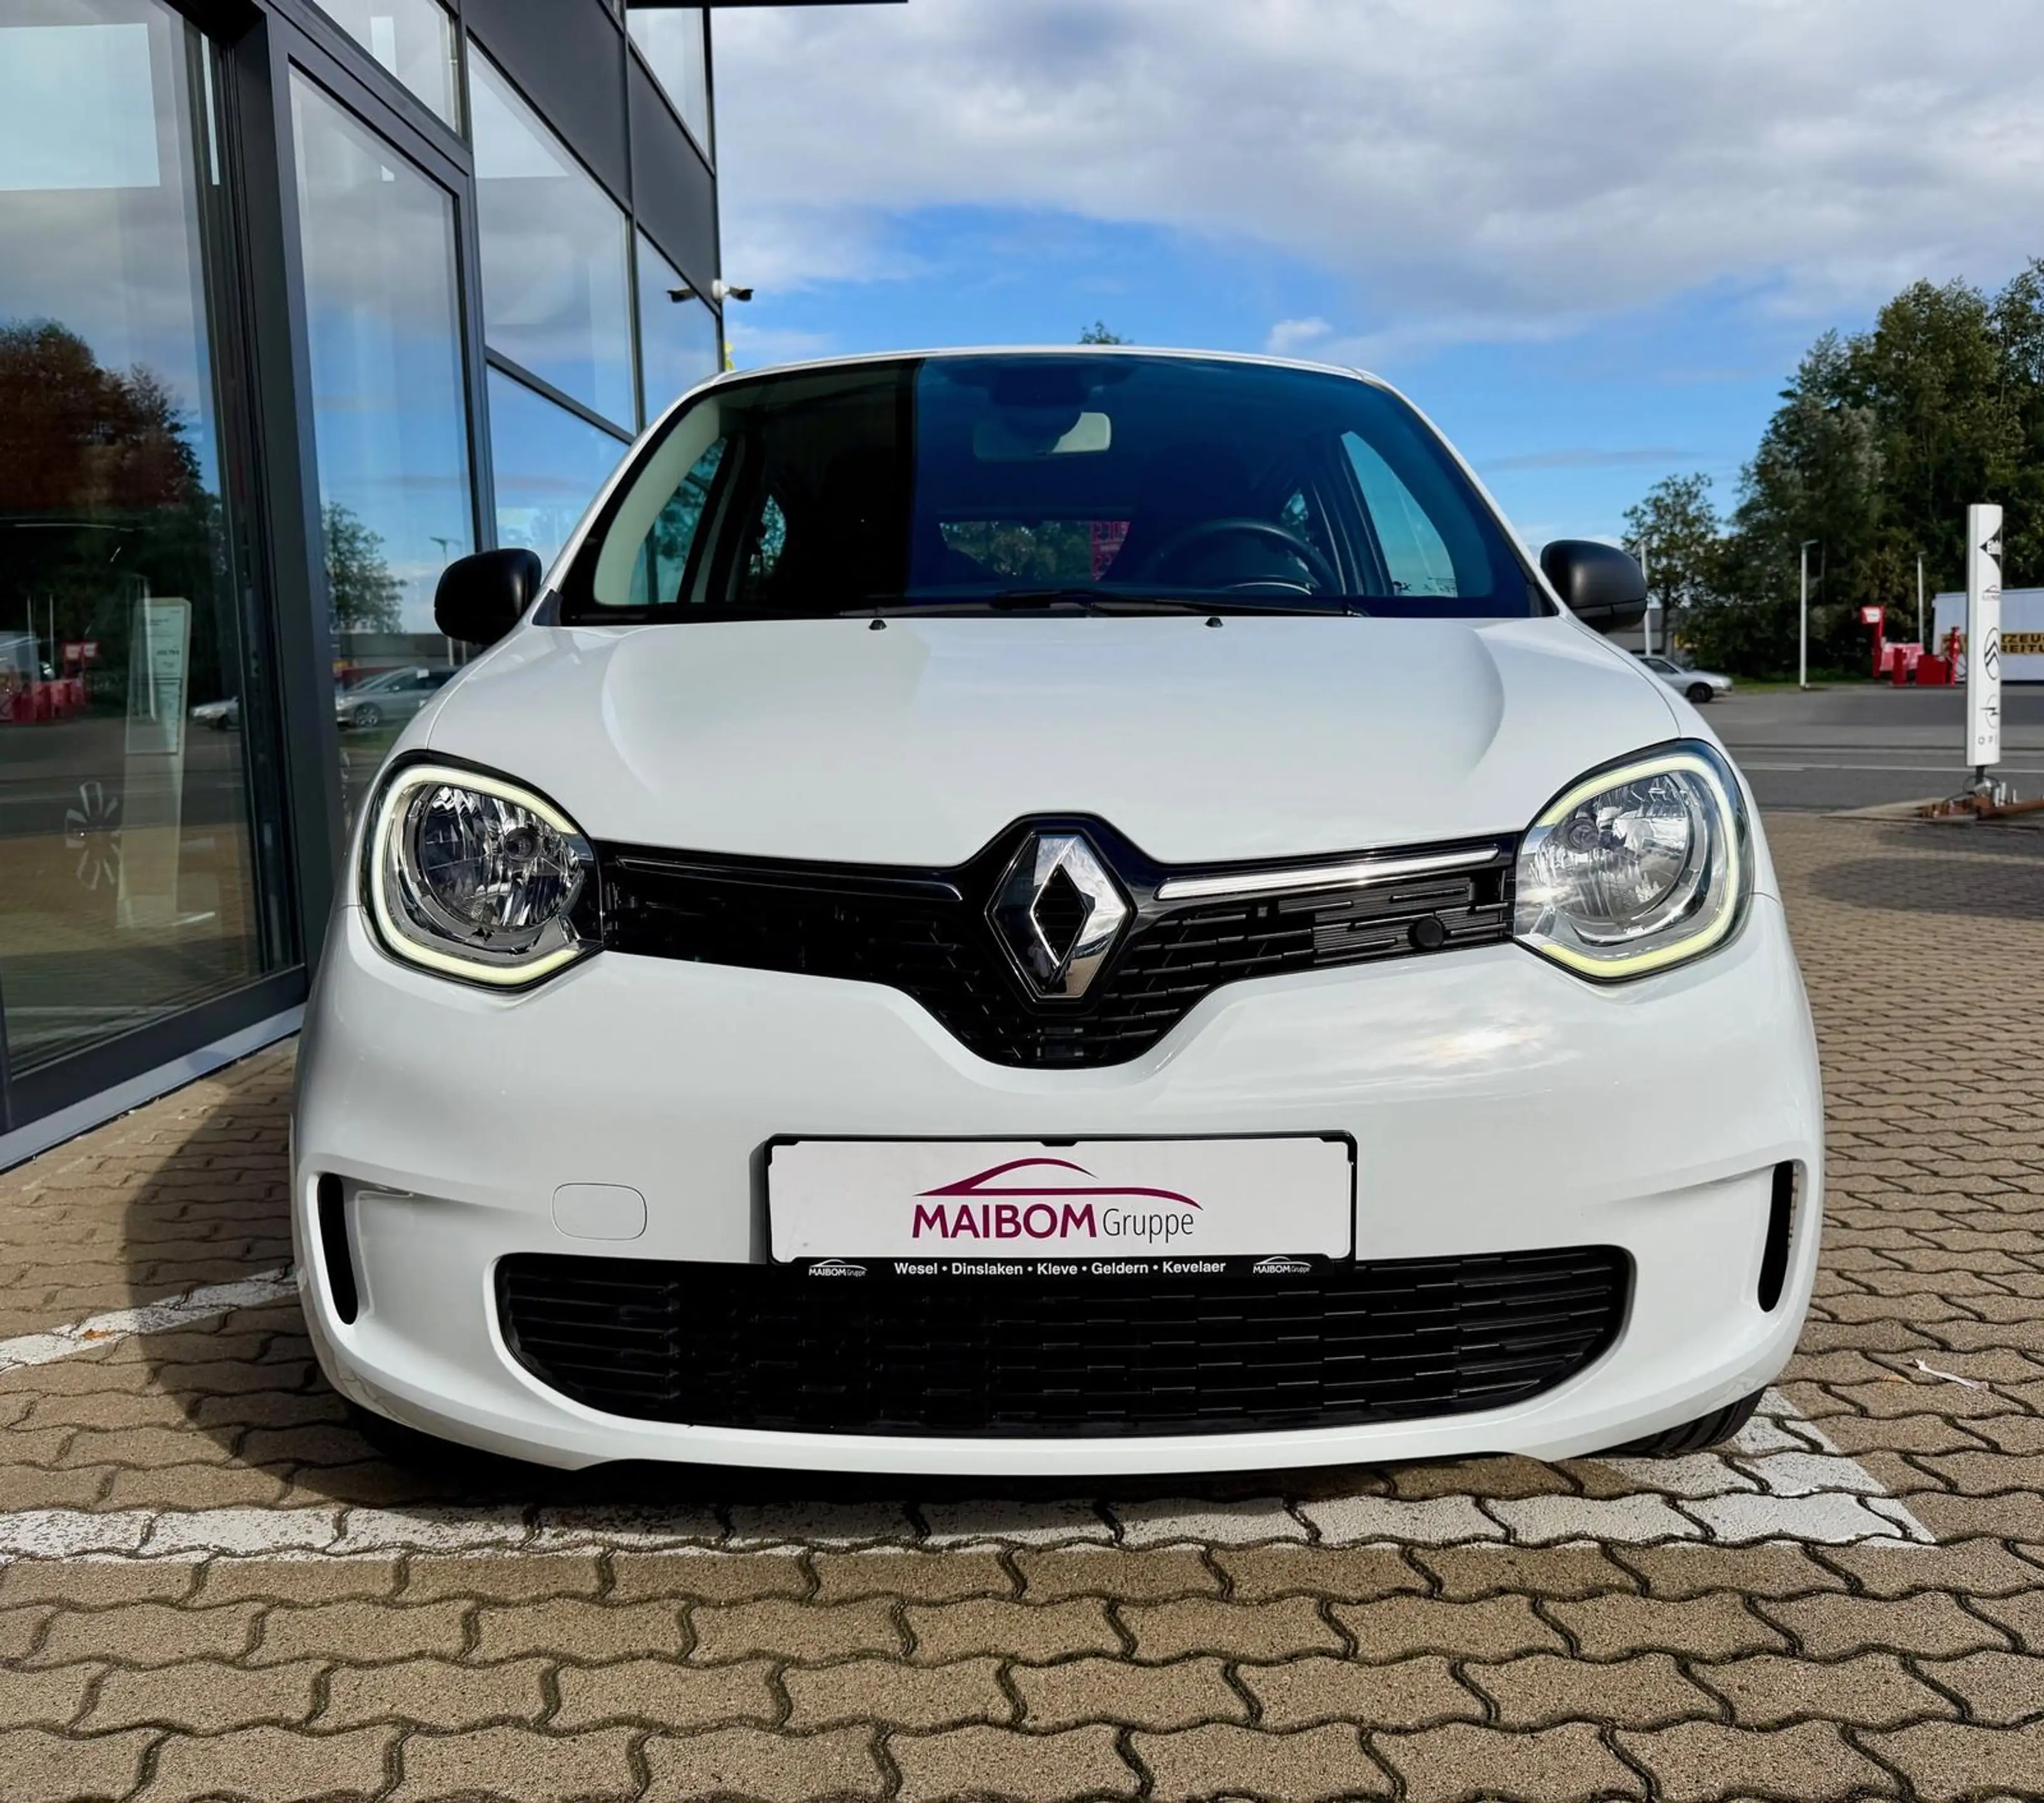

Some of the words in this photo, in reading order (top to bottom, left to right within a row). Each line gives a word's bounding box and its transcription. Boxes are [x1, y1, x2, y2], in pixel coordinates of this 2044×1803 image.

[912, 1203, 1097, 1238] MAIBOM
[1102, 1208, 1194, 1243] Gruppe
[809, 1268, 846, 1276] MAIBOM
[846, 1268, 866, 1276] Gruppe
[894, 1262, 938, 1275] Wesel
[952, 1262, 1023, 1275] Dinslaken
[1037, 1263, 1077, 1275] Kleve
[1091, 1262, 1149, 1274] Geldern
[1163, 1261, 1226, 1273] Kevelaer
